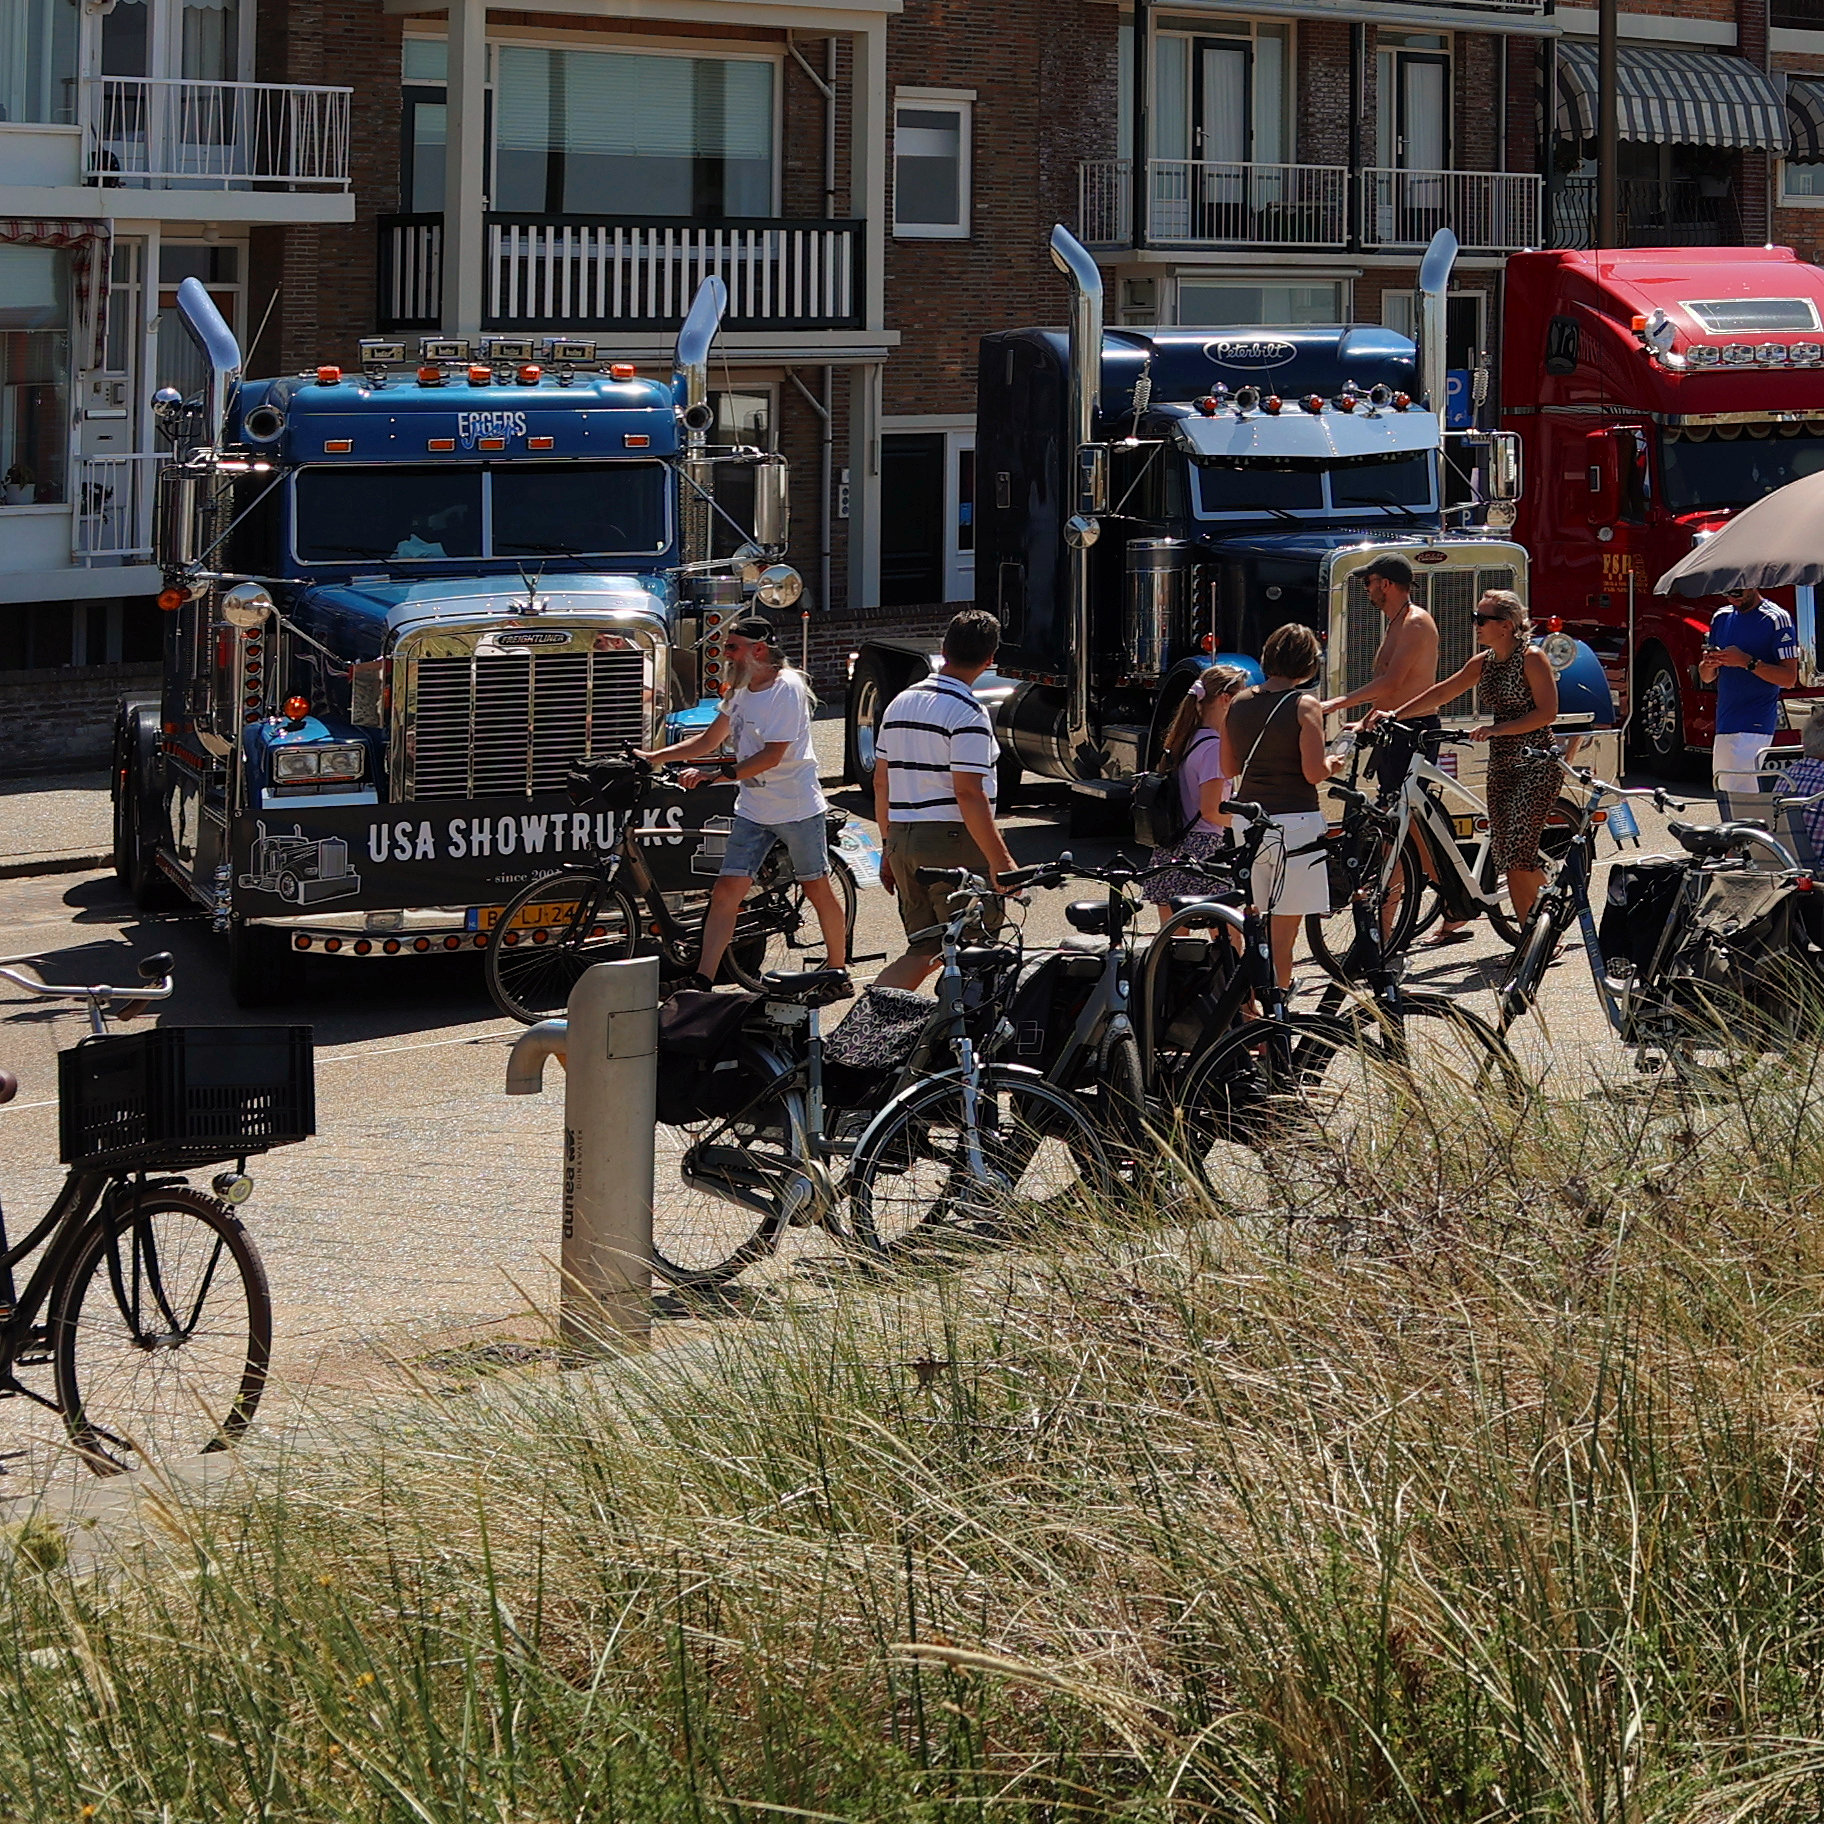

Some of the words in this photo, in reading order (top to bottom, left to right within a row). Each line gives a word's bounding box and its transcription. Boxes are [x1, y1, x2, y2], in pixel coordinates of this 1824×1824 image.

[1216, 342, 1288, 360] Peterbilt
[1446, 377, 1463, 405] P
[457, 411, 527, 437] EGGERS
[501, 634, 564, 644] FREIGHTLINER
[368, 821, 435, 863] USA
[494, 872, 528, 884] since
[487, 905, 577, 927] B-LJ-24
[562, 1167, 575, 1239] dunea
